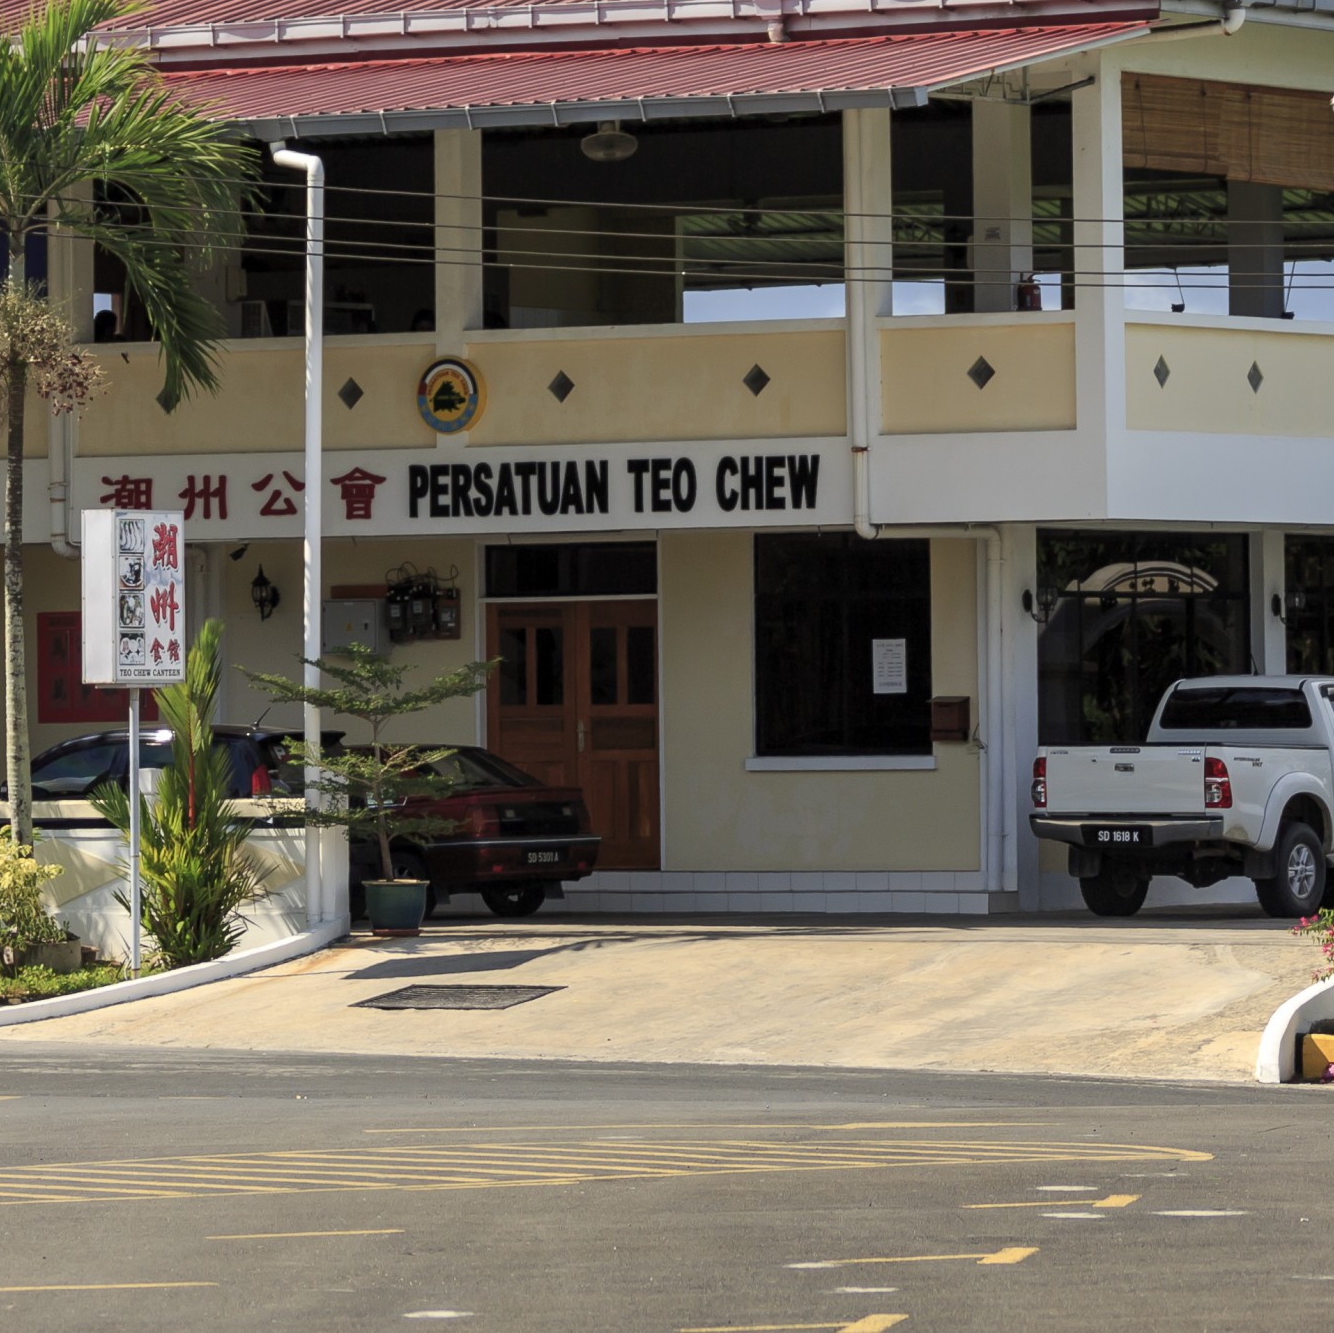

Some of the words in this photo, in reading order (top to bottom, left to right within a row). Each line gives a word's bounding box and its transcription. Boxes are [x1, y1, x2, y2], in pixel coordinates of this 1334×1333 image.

[408, 460, 609, 518] PERSATUAN
[627, 456, 697, 513] TEO
[716, 454, 820, 512] CHEW
[100, 467, 387, 520] 潮州公會
[119, 669, 132, 677] TEO
[133, 669, 151, 677] CHEW
[152, 668, 181, 677] CANTEEN
[1098, 831, 1110, 842] SD
[1113, 831, 1131, 842] 1618
[1133, 831, 1140, 842] K
[528, 852, 537, 863] SD
